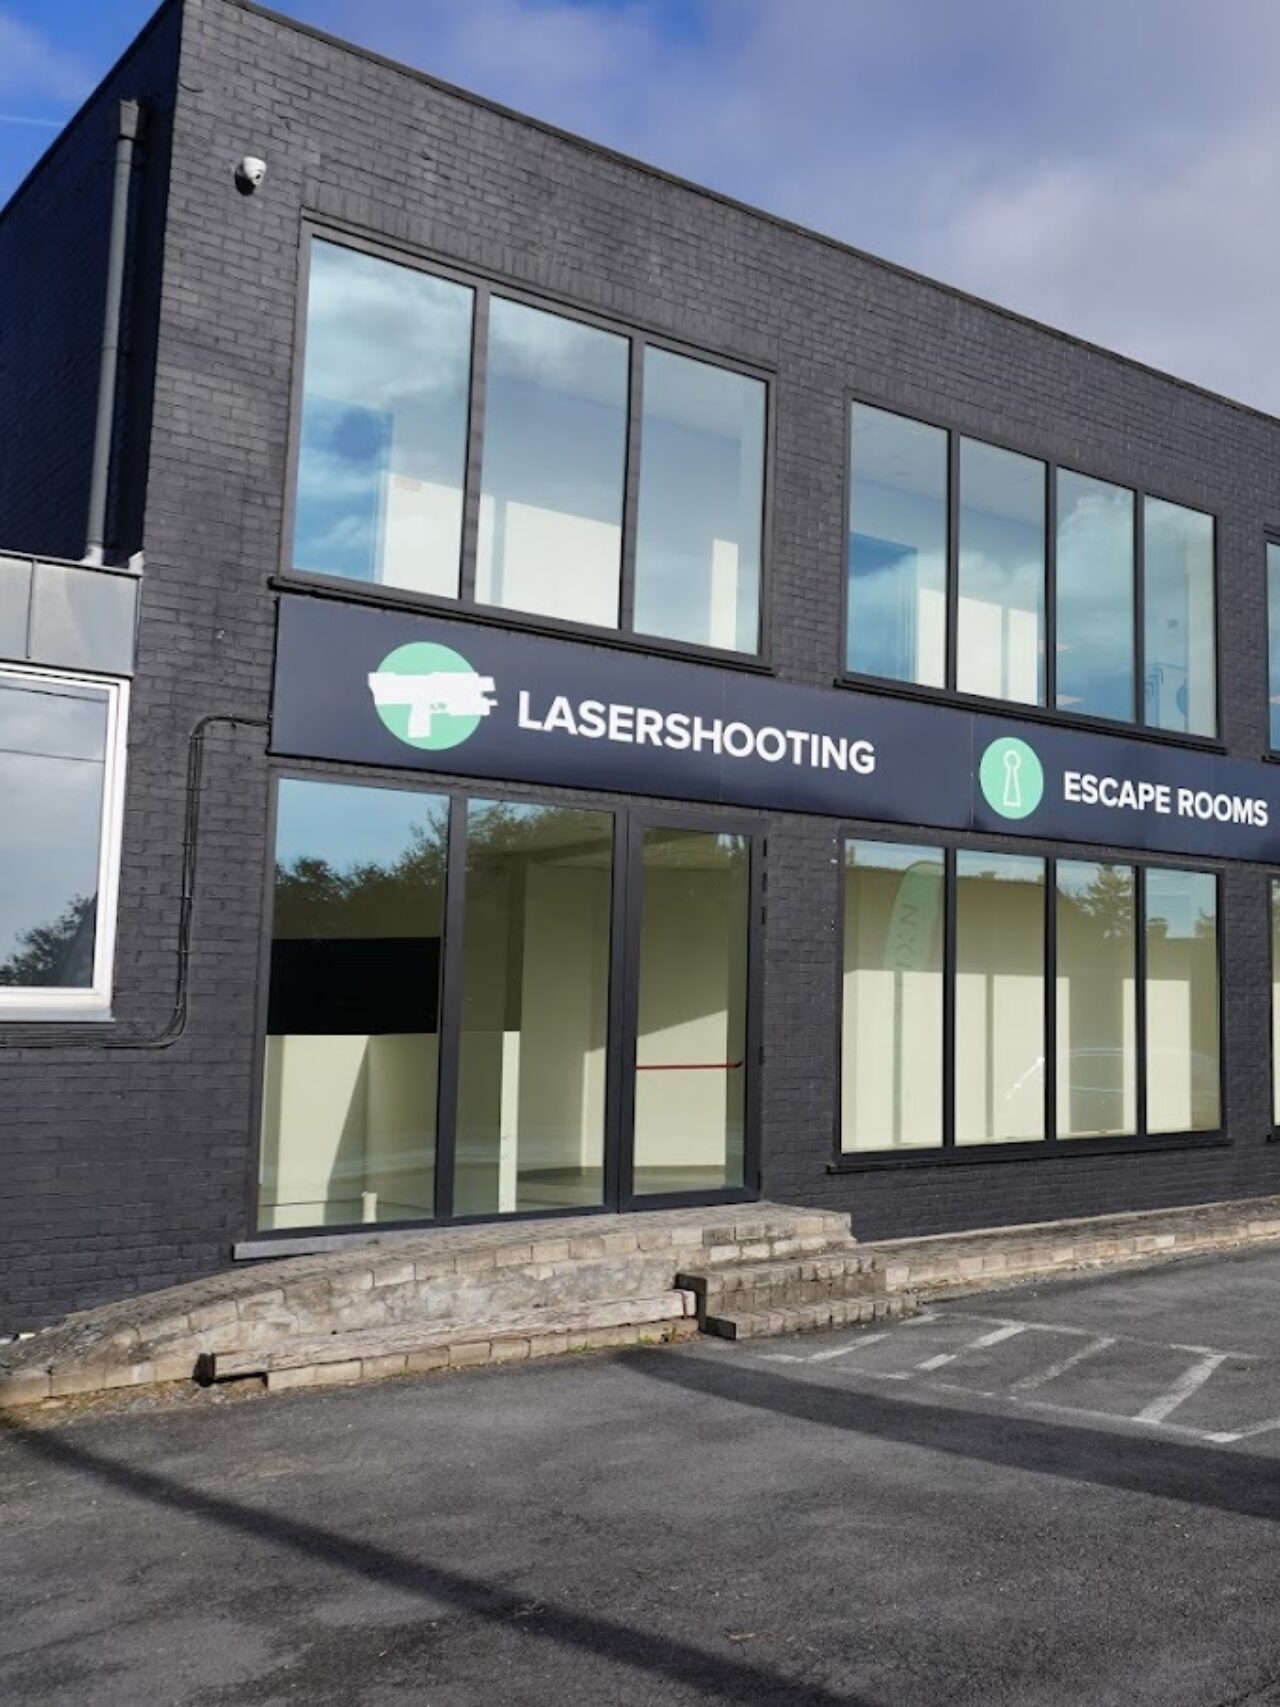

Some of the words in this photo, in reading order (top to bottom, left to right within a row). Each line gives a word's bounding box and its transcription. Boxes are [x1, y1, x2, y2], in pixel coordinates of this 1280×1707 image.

[517, 689, 876, 776] LASERSHOOTING
[1064, 770, 1171, 815] ESCAPE
[1177, 788, 1269, 828] ROOMS
